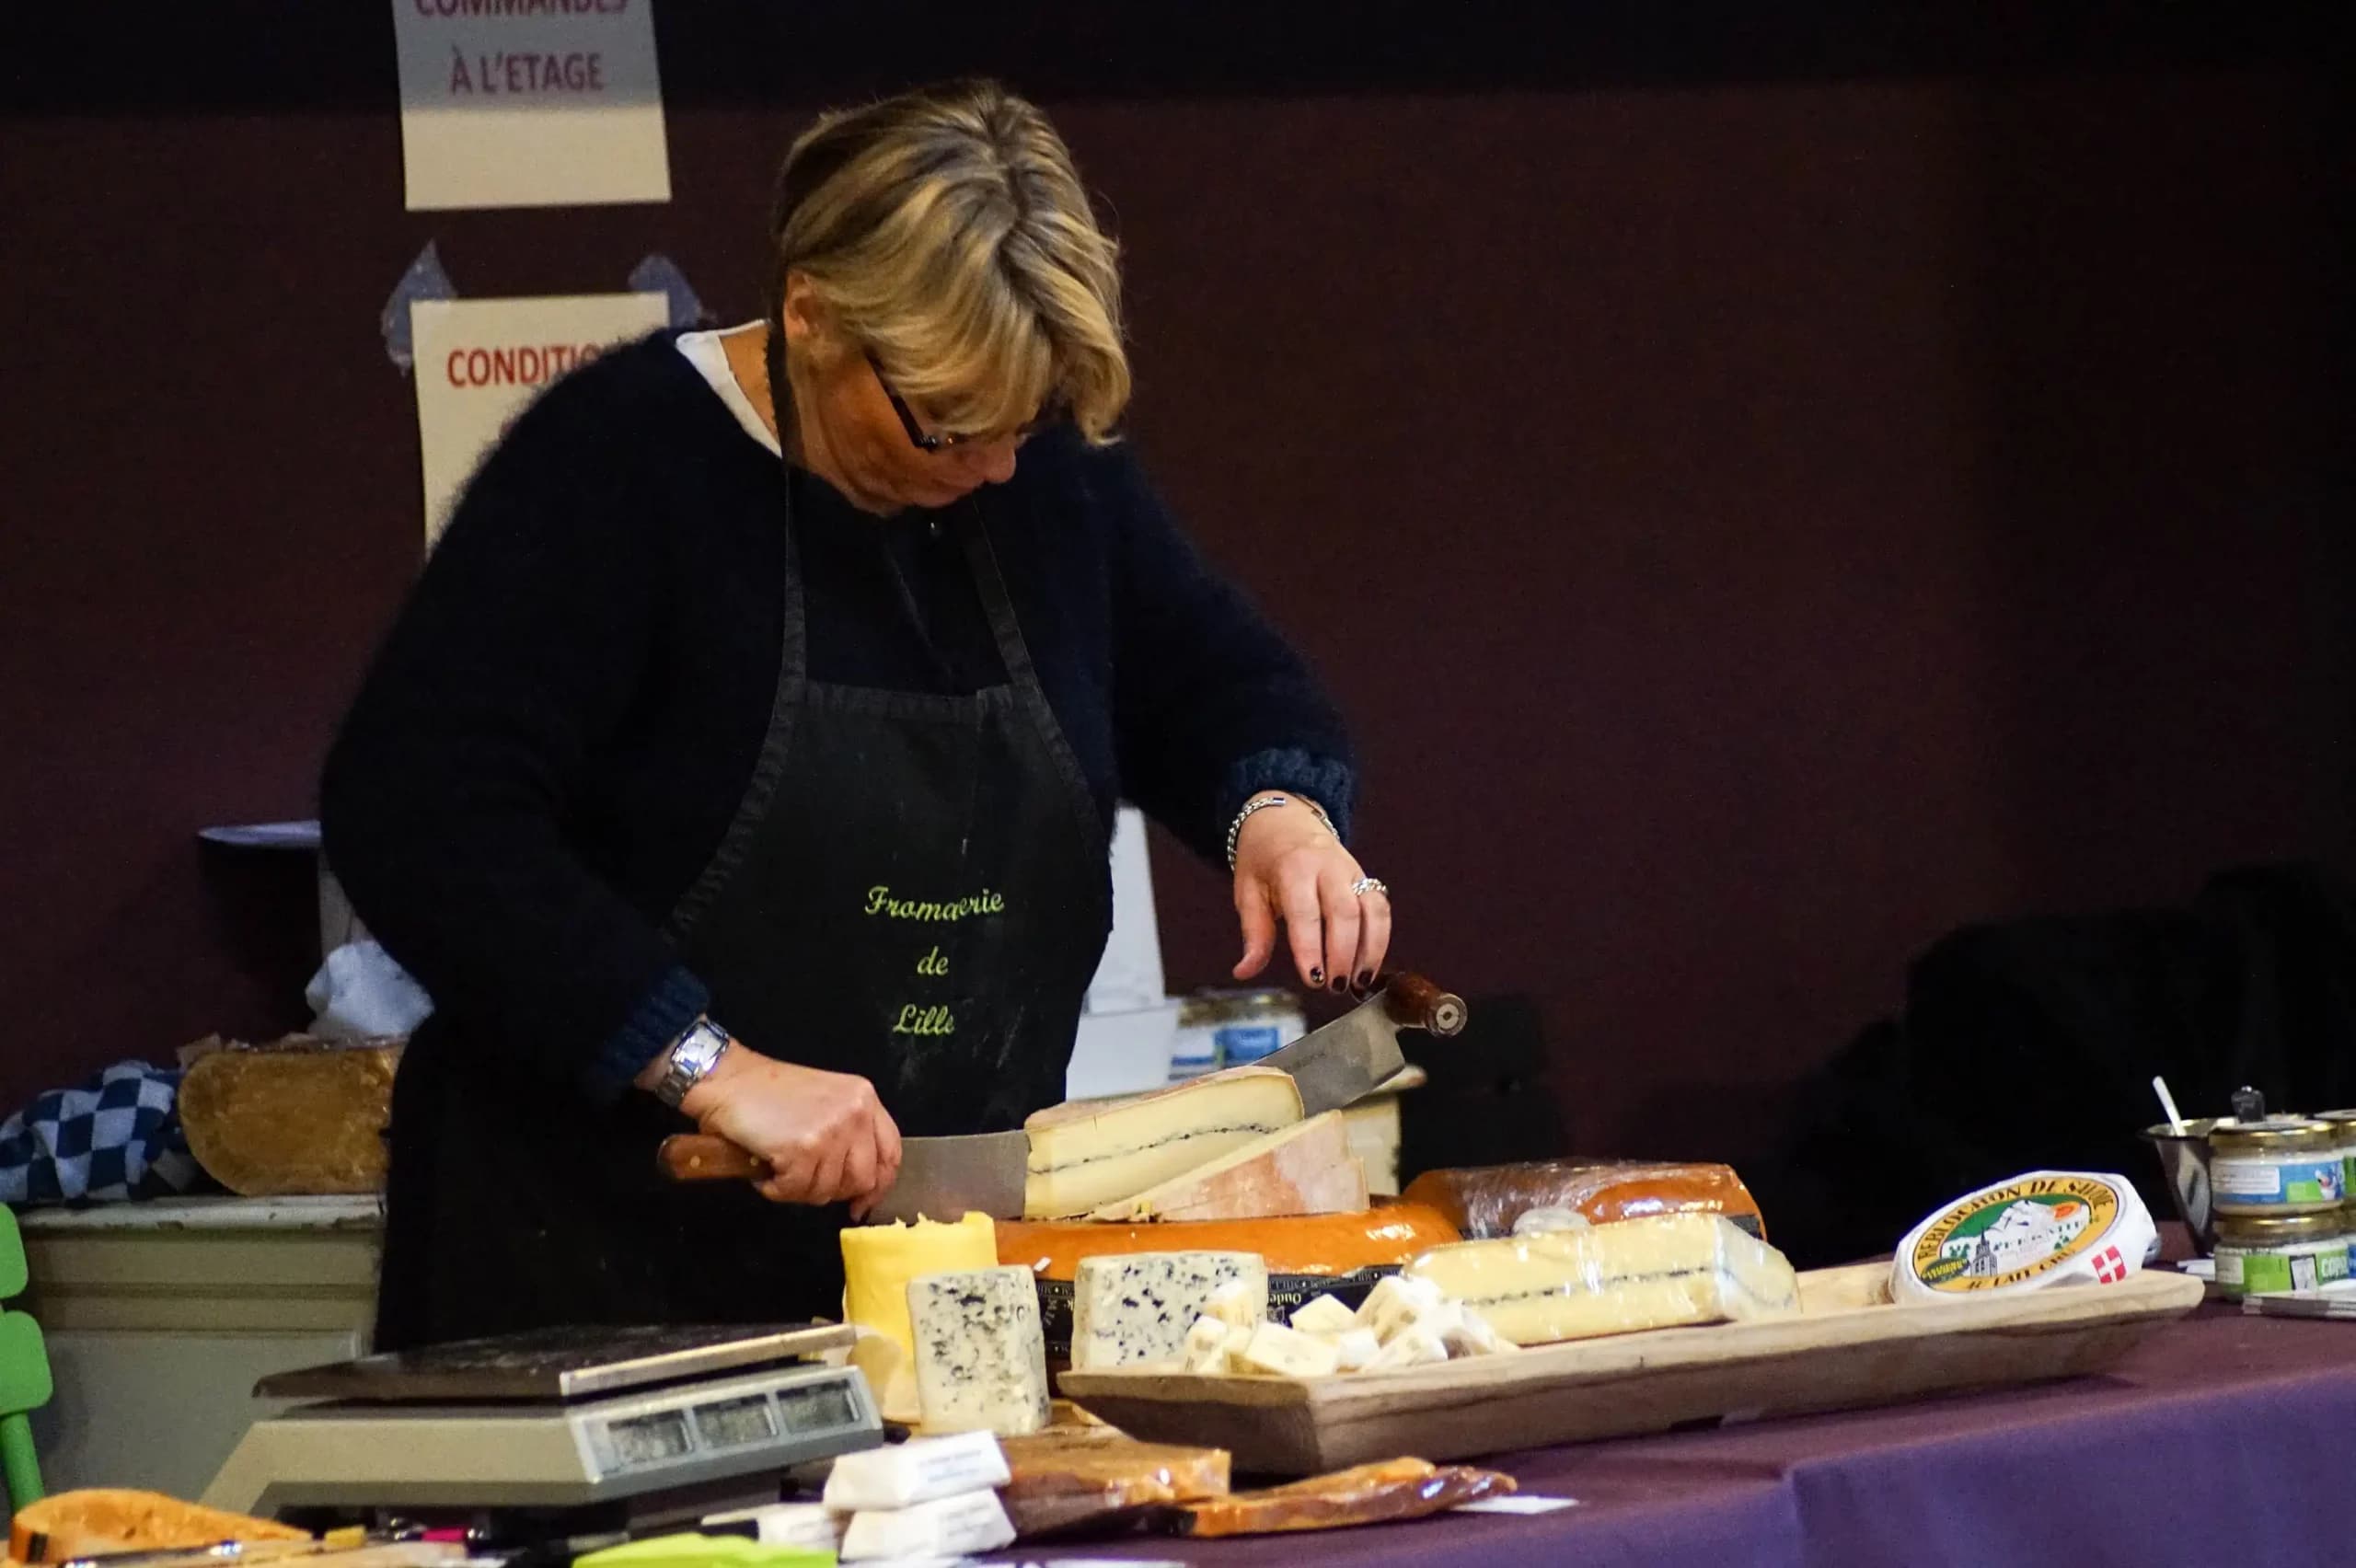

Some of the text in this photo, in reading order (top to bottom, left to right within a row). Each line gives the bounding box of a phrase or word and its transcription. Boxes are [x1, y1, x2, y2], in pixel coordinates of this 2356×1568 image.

[450, 45, 473, 95] À
[918, 946, 949, 975] de
[893, 1004, 954, 1035] Lille
